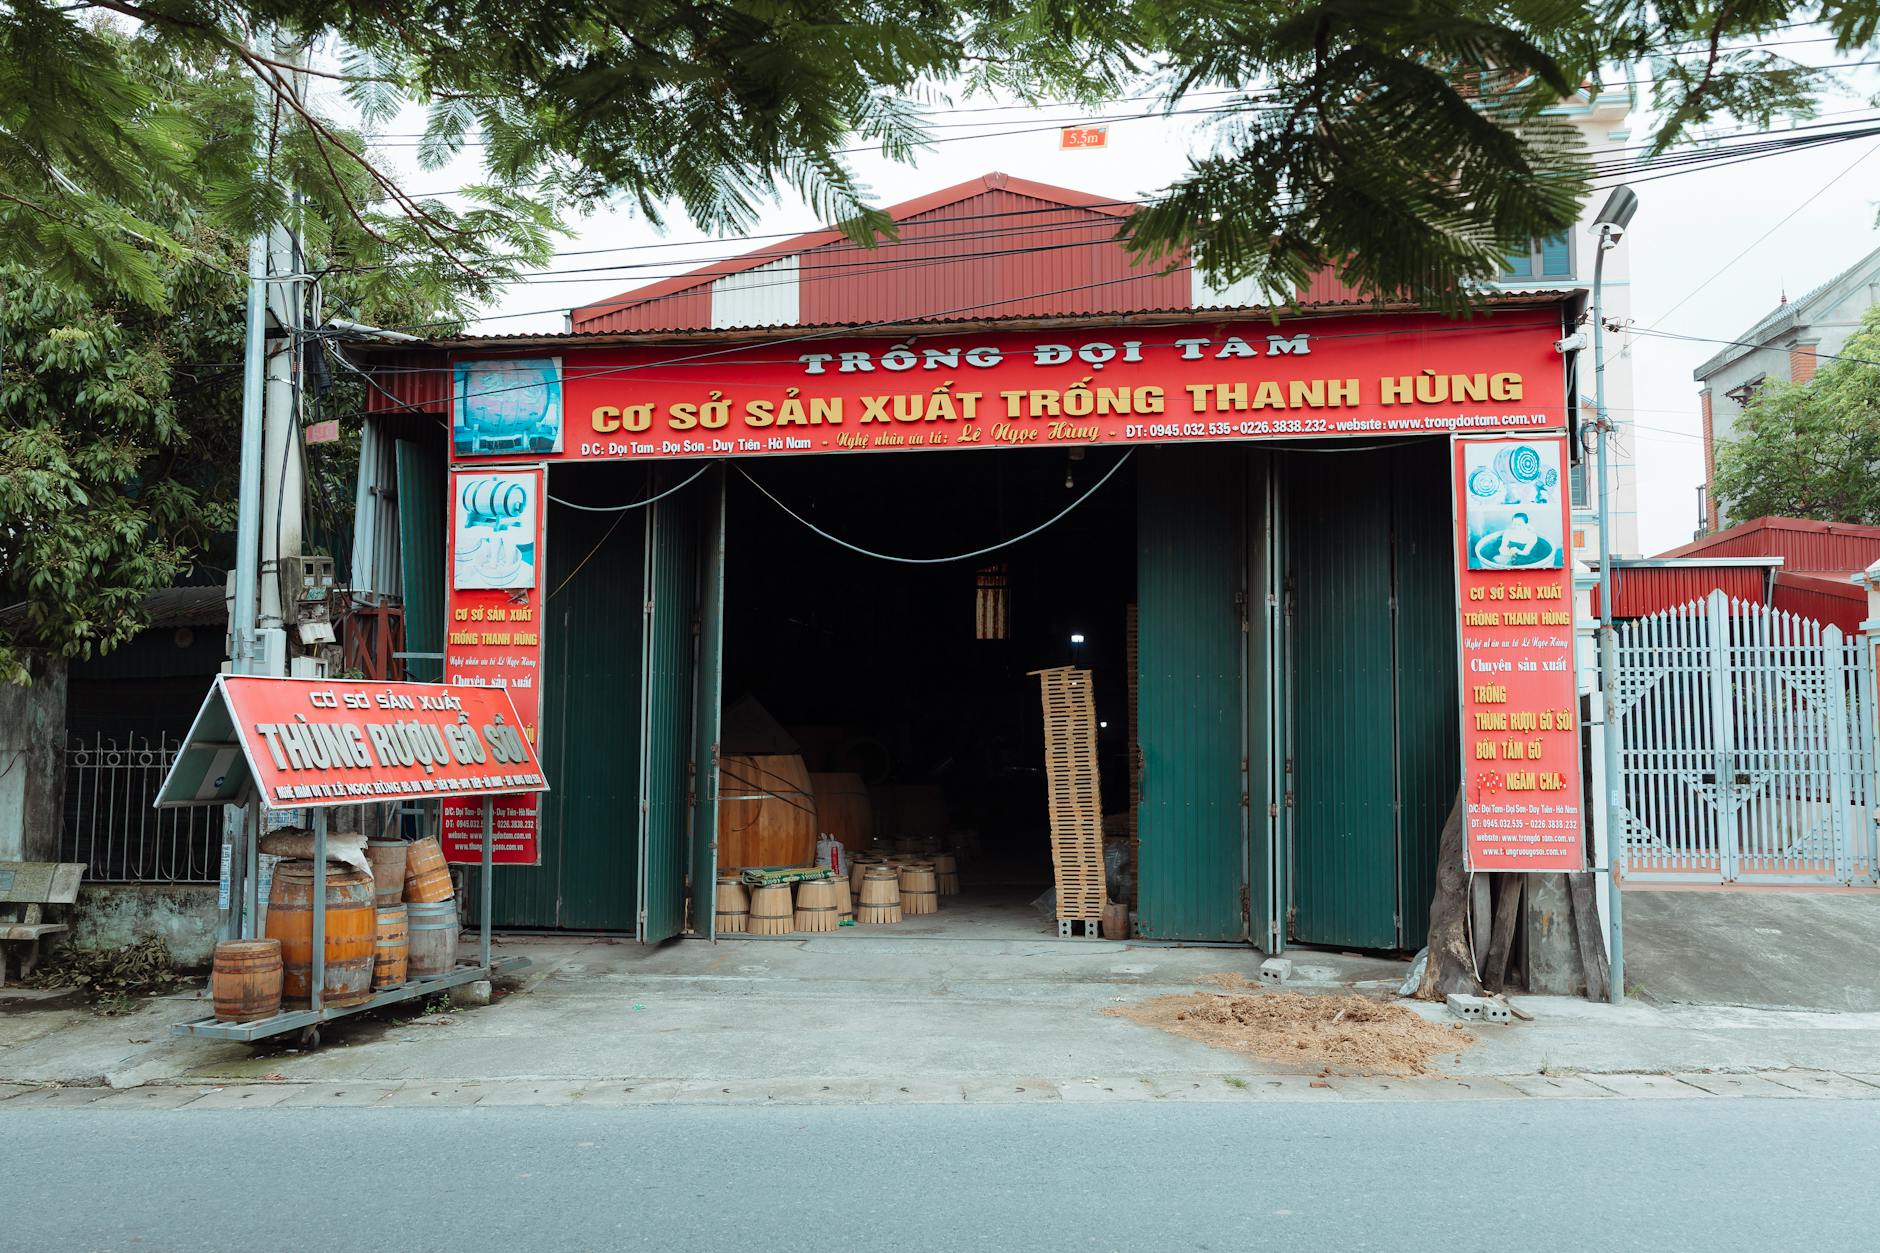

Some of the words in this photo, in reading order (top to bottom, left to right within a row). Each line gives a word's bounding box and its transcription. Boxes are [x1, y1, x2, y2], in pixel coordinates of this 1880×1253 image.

[799, 337, 1003, 374] TRỐNG
[1034, 341, 1143, 370] ĐỌI
[1175, 336, 1311, 359] TAM
[592, 403, 656, 433] CƠ
[669, 390, 732, 430] SỞ
[744, 387, 842, 427] SẢN
[859, 380, 982, 423] XUẤT
[1000, 376, 1164, 417] TRỐNG
[1186, 379, 1359, 412] THANH
[1380, 369, 1522, 404] HÙNG
[609, 442, 627, 457] Đọi
[631, 441, 654, 454] Tam
[684, 439, 704, 452] Sơn
[713, 439, 734, 454] Duy
[738, 438, 761, 452] Tiên
[768, 437, 783, 451] Hà
[785, 437, 811, 450] Nam
[837, 432, 868, 449] Nghệ
[874, 432, 904, 446] nhân
[957, 424, 982, 443] Lê
[991, 423, 1037, 444] Ngọc
[1047, 421, 1100, 442] Hùng
[1126, 425, 1147, 438] ĐT:
[1240, 420, 1326, 434] 0226.3838.232
[1469, 586, 1485, 600] CƠ
[1490, 584, 1505, 600] SỞ
[1509, 582, 1531, 600] SẢN
[1536, 581, 1562, 599] XUẤT
[455, 608, 468, 621] CƠ
[471, 605, 484, 621] SỞ
[487, 605, 505, 621] SẢN
[510, 606, 532, 621] XUẤT
[1503, 612, 1538, 625] THANH
[1542, 609, 1570, 625] HÙNG
[482, 633, 510, 645] THANH
[514, 631, 538, 646] HÙNG
[1471, 658, 1512, 675] Chuyên
[1517, 657, 1537, 671] sản
[1542, 655, 1567, 671] xuất
[511, 673, 532, 688] xuất
[309, 689, 337, 708] CƠ
[376, 688, 414, 710] SẢN
[417, 689, 463, 711] XUẤT
[1473, 681, 1507, 704] TRỐNG
[1474, 710, 1507, 731] THÙNG
[1510, 711, 1536, 733] RƯỢU
[1540, 708, 1555, 731] GỖ
[1556, 707, 1573, 731] SỒI
[255, 713, 373, 770] THÙNG
[364, 719, 450, 773] RƯỢU
[444, 711, 487, 765] GỖ
[482, 713, 530, 764] SỒI
[1527, 737, 1543, 760] GỖ
[331, 781, 347, 796] LÊ
[373, 780, 401, 794] HÙNG
[1505, 768, 1536, 791] NGÂM
